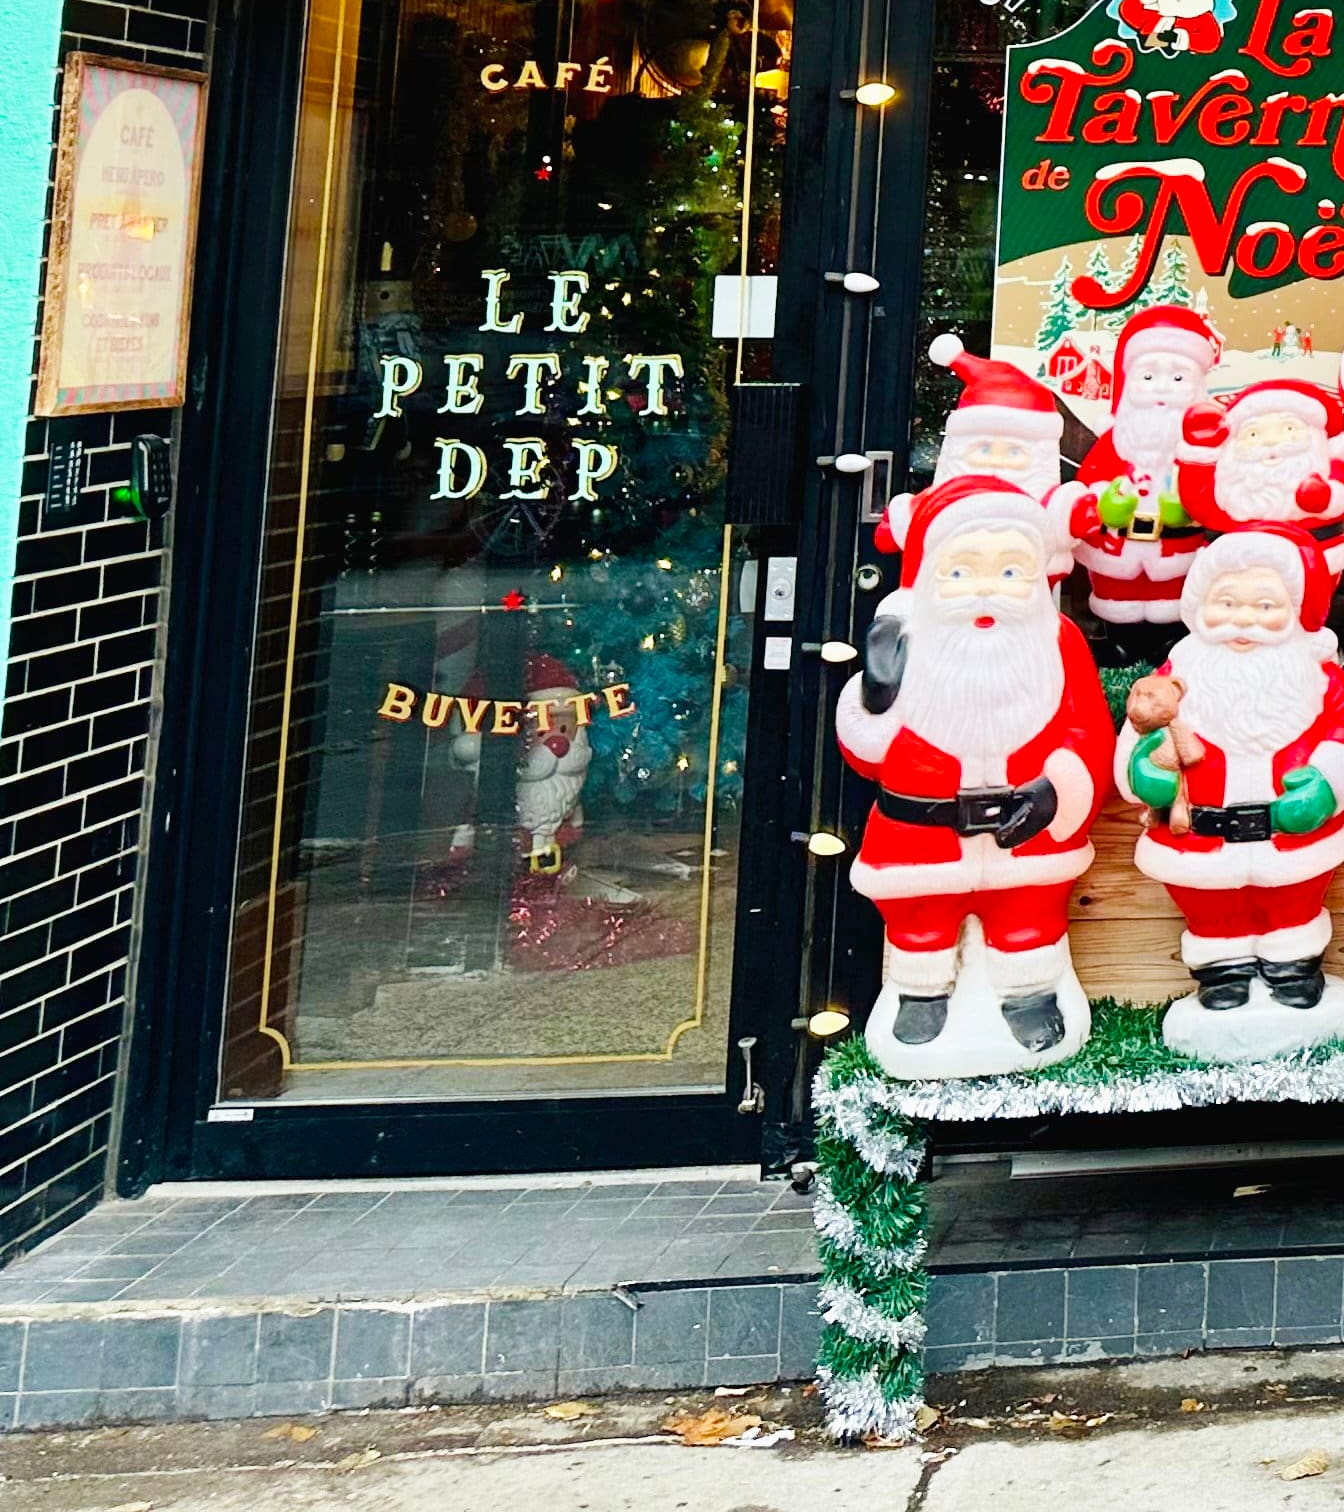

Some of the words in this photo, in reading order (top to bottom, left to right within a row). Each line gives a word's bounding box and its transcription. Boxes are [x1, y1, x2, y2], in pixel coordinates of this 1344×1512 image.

[479, 56, 615, 94] CAFÉ
[1022, 159, 1072, 191] de
[479, 269, 590, 334] LE
[374, 353, 684, 419] PETIT
[430, 436, 618, 501] DEP
[377, 683, 638, 736] BUVETTE
